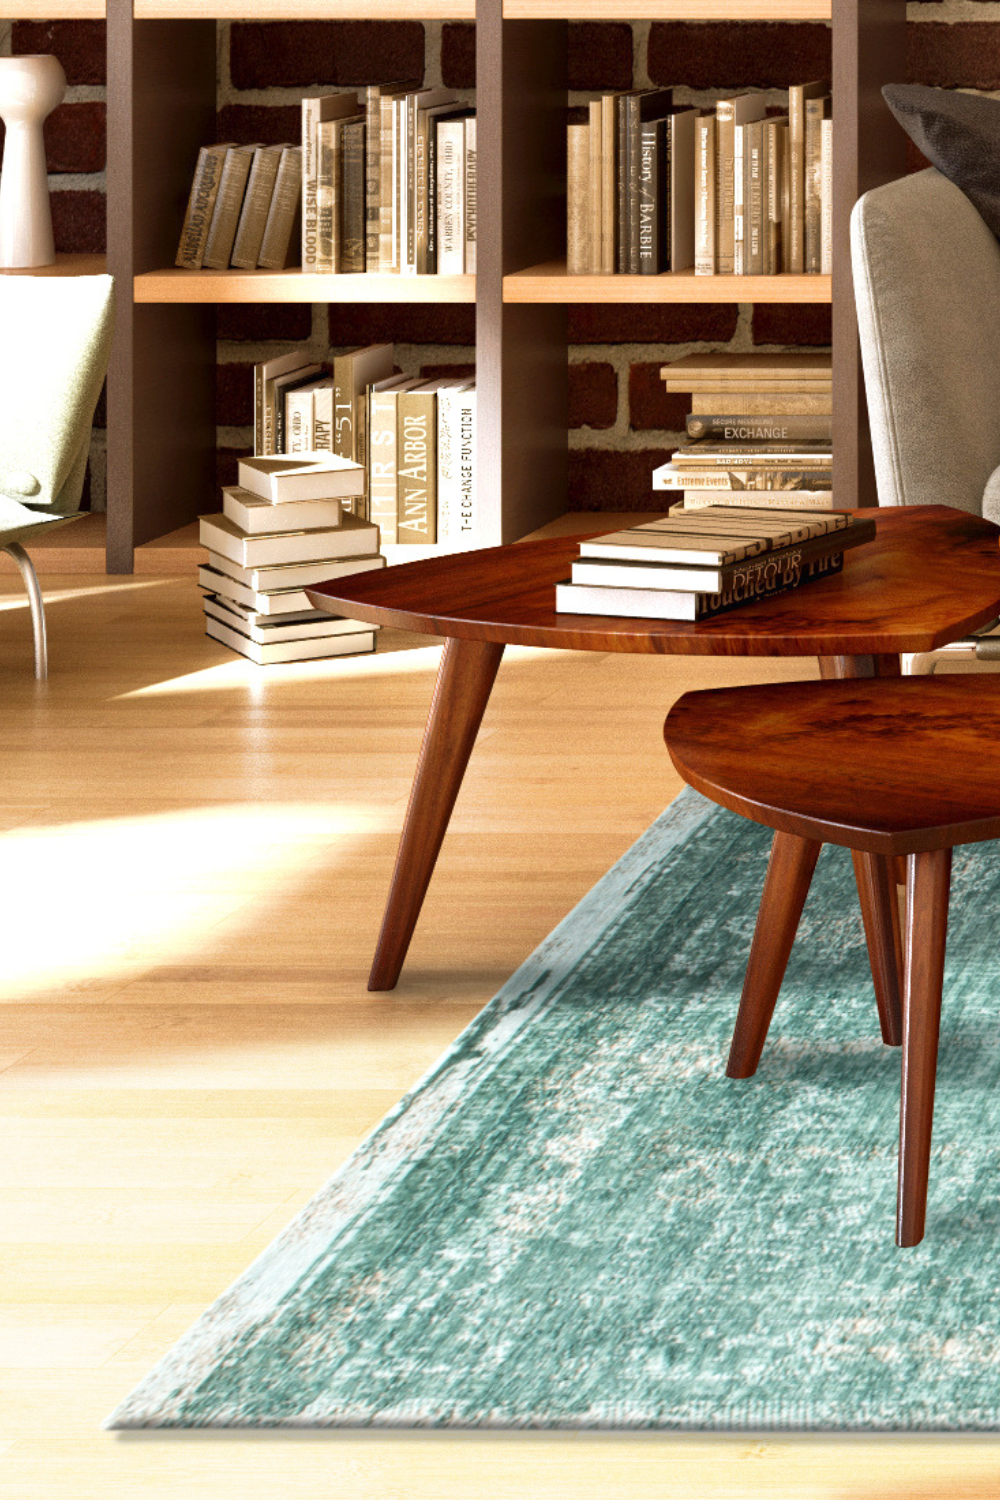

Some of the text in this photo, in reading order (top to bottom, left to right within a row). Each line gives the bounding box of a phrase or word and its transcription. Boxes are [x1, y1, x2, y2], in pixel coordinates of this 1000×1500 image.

[638, 131, 656, 183] History
[306, 179, 317, 217] WISE
[444, 141, 453, 253] WARREN COUNTY, OHIO
[305, 219, 317, 265] BLOOD
[639, 204, 655, 259] BARBIE
[293, 411, 302, 436] OHIO
[461, 408, 472, 461] FUNCTION
[724, 427, 788, 439] EXCHANGE
[397, 414, 427, 534] ANN ARBOR
[461, 466, 472, 509] CHANGE
[677, 476, 728, 486] Extreme Events
[732, 553, 802, 590] DETOUR
